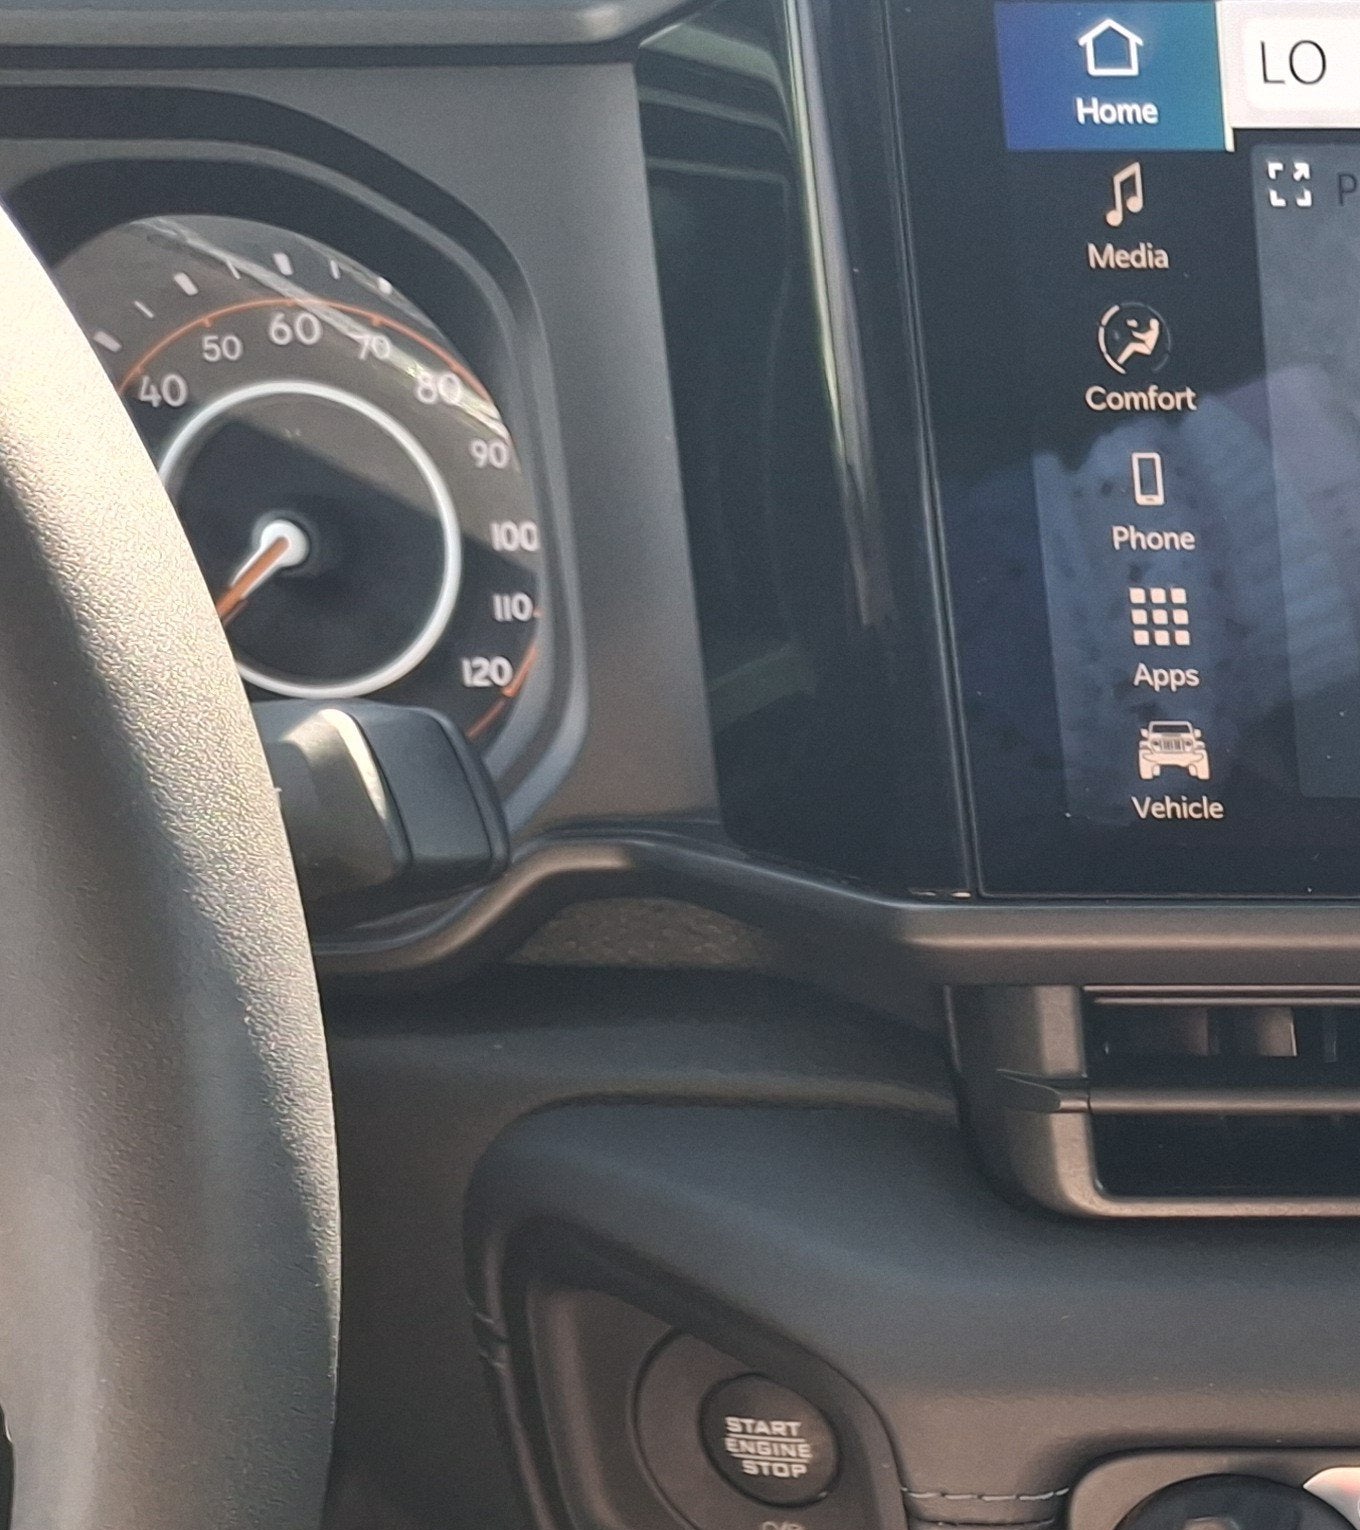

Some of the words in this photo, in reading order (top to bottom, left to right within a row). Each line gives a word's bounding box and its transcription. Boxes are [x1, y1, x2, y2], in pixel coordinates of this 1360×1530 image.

[1260, 39, 1328, 86] LO
[1075, 98, 1159, 125] Home
[1087, 243, 1169, 270] Media
[268, 313, 321, 345] 60
[201, 335, 242, 363] 50
[356, 334, 390, 362] 70
[139, 374, 187, 407] 40
[413, 372, 461, 404] 80
[1085, 385, 1198, 412] Comfort
[469, 441, 508, 470] 90
[490, 522, 539, 552] 100
[1111, 525, 1196, 551] Phone
[492, 594, 533, 622] 110
[461, 658, 512, 687] 120
[1132, 662, 1200, 693] Apps
[1131, 795, 1224, 820] Vehicle
[724, 1416, 801, 1437] START
[725, 1439, 812, 1458] ENGINE
[742, 1460, 807, 1478] STOP
